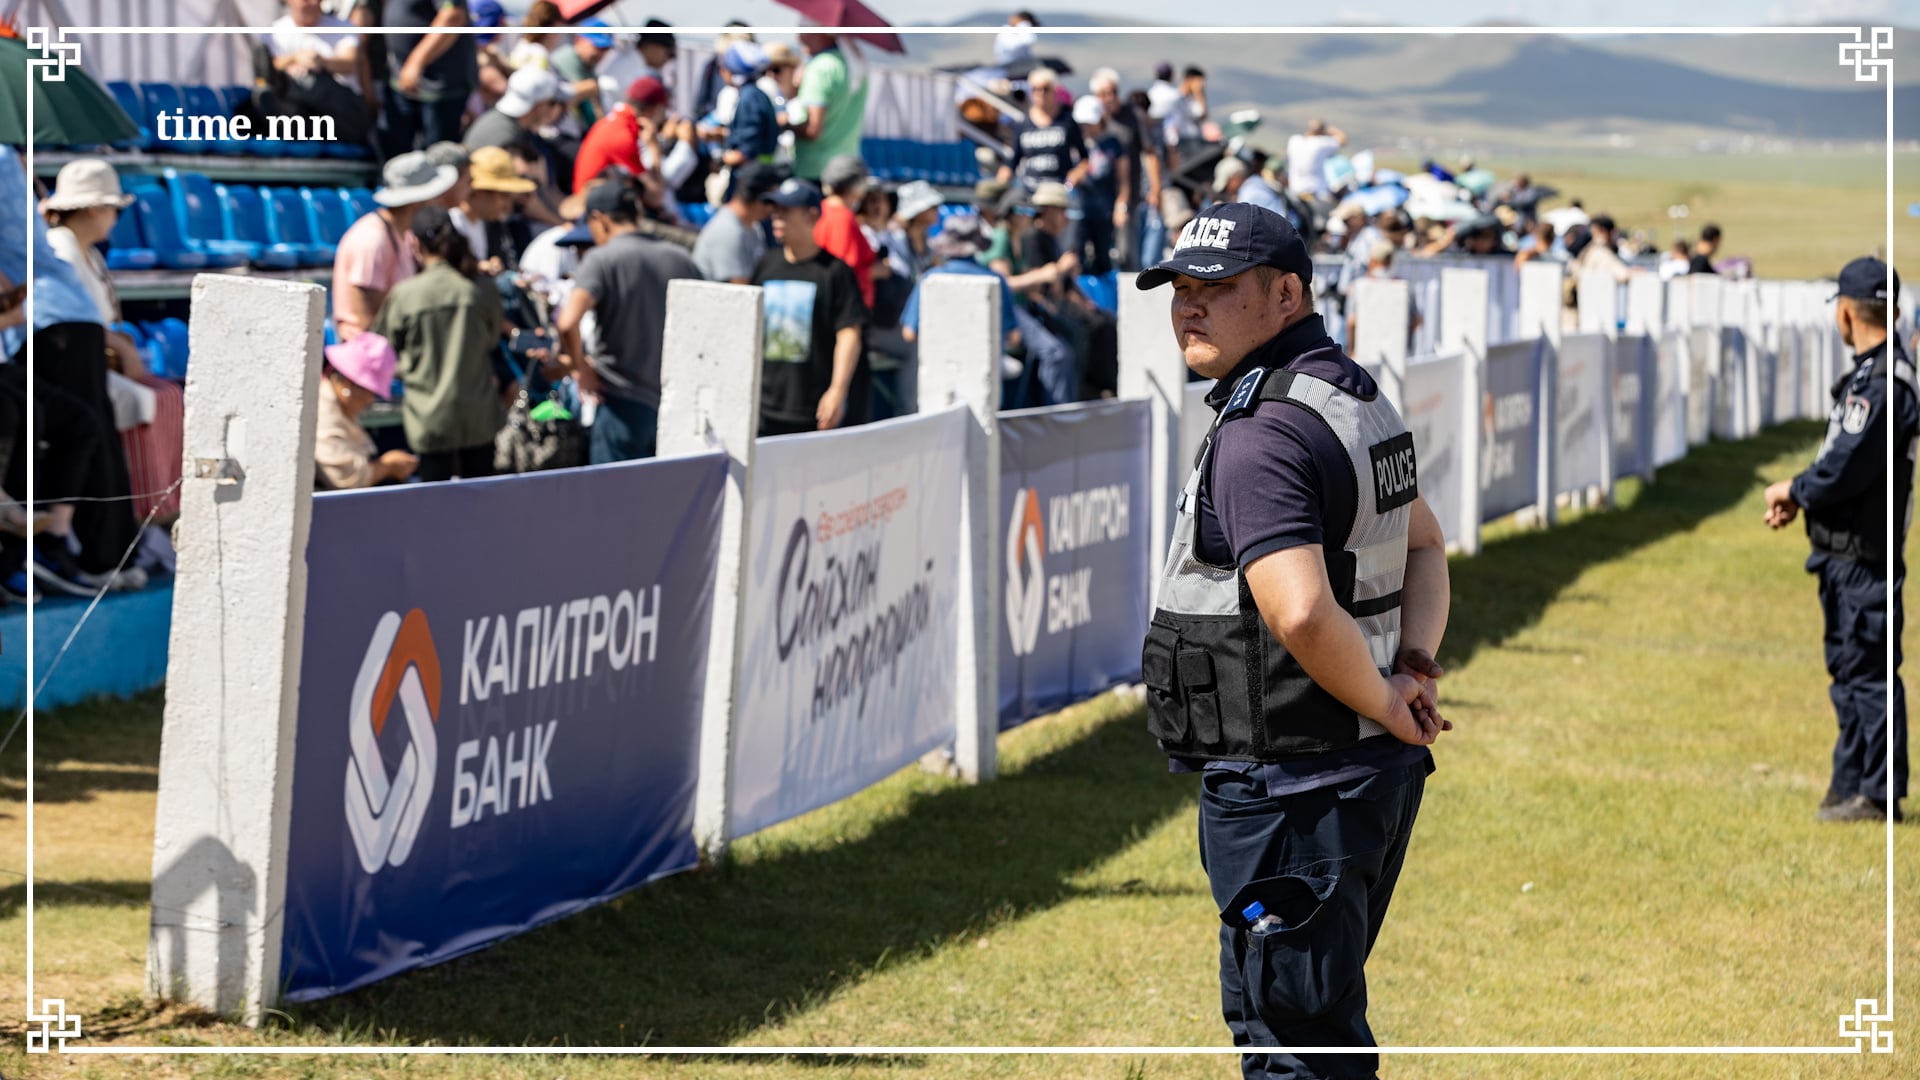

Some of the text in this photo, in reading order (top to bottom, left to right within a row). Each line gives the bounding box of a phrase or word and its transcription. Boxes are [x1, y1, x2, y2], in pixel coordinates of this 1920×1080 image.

[1188, 264, 1224, 273] POLICE
[1376, 448, 1415, 499] POLICE
[1049, 482, 1131, 554] КАПИТРОН
[1047, 566, 1092, 634] БАНК
[459, 584, 661, 704] КАПИТРОН
[450, 720, 557, 829] БАНК
